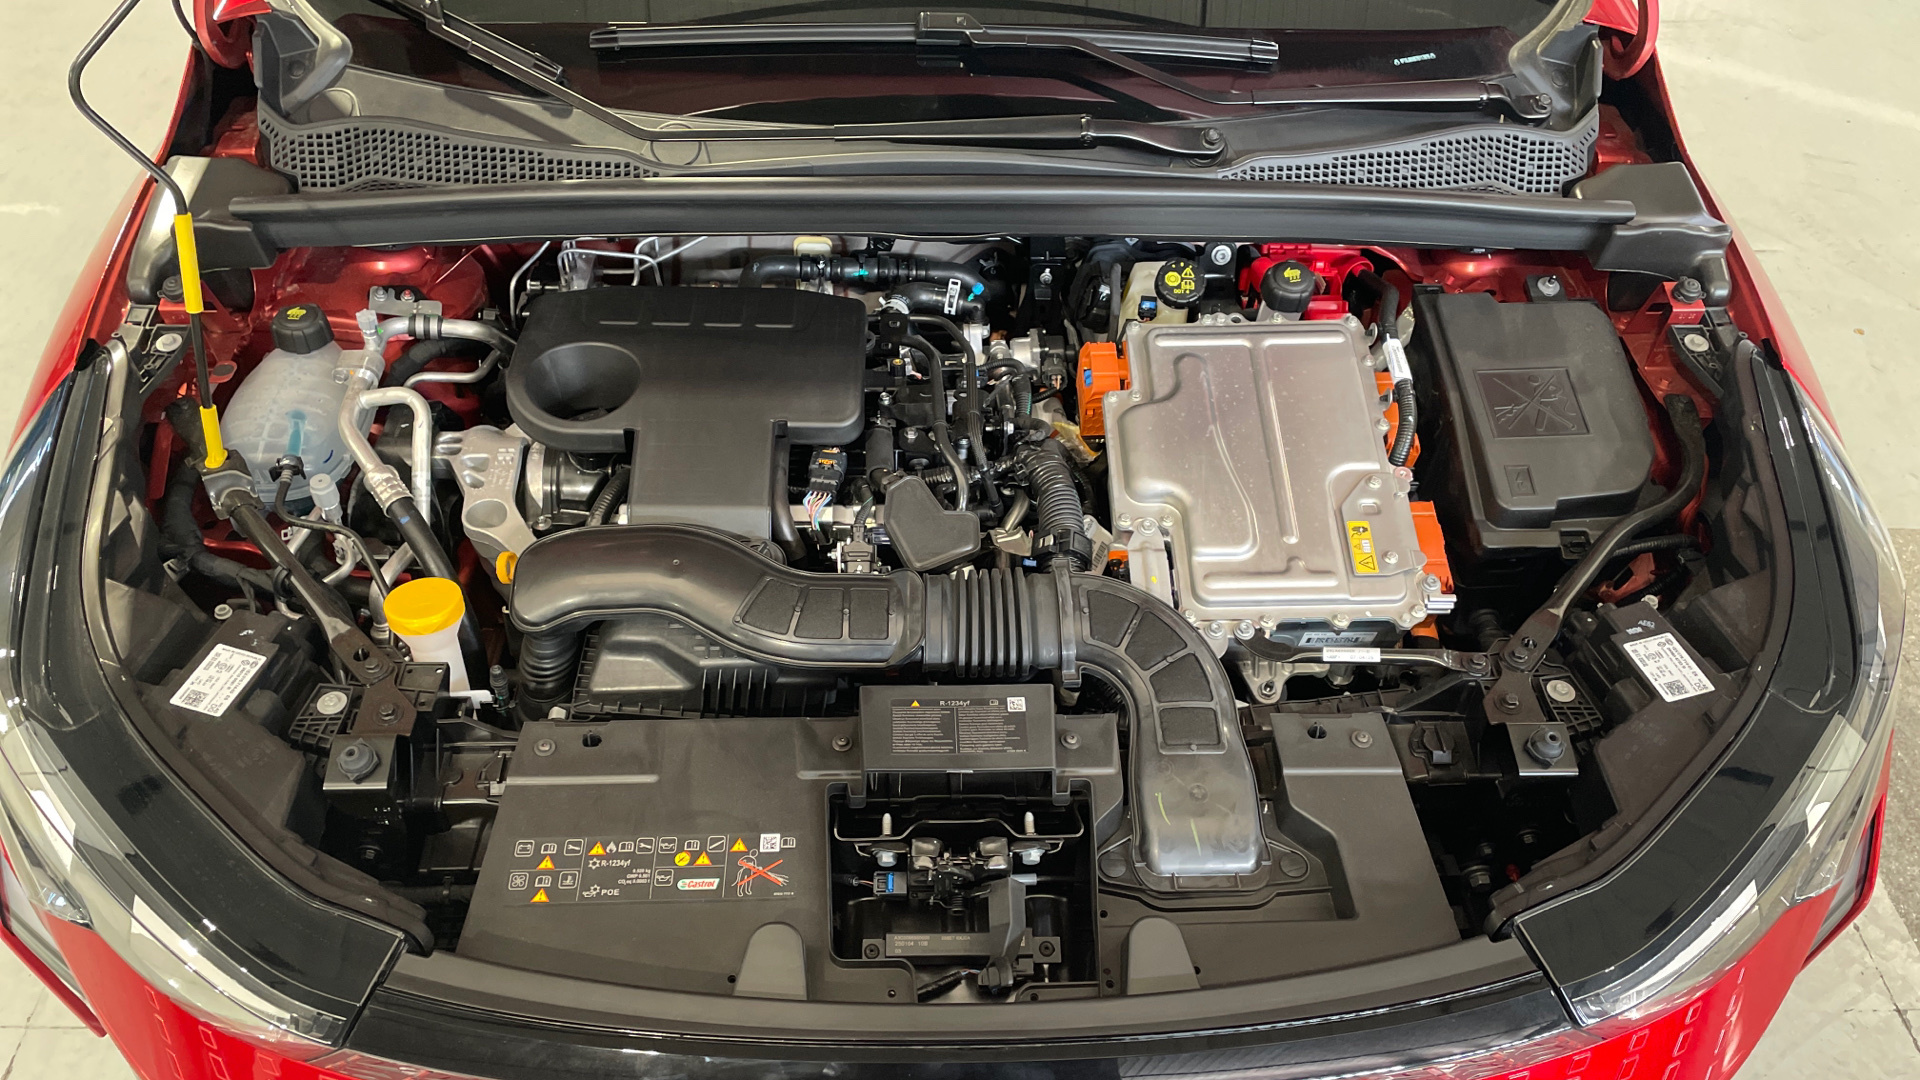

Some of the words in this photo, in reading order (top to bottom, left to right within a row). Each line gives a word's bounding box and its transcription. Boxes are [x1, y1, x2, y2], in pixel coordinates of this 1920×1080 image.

[600, 859, 631, 868] R-1234yf
[687, 879, 716, 888] Castrol
[600, 888, 620, 896] POE
